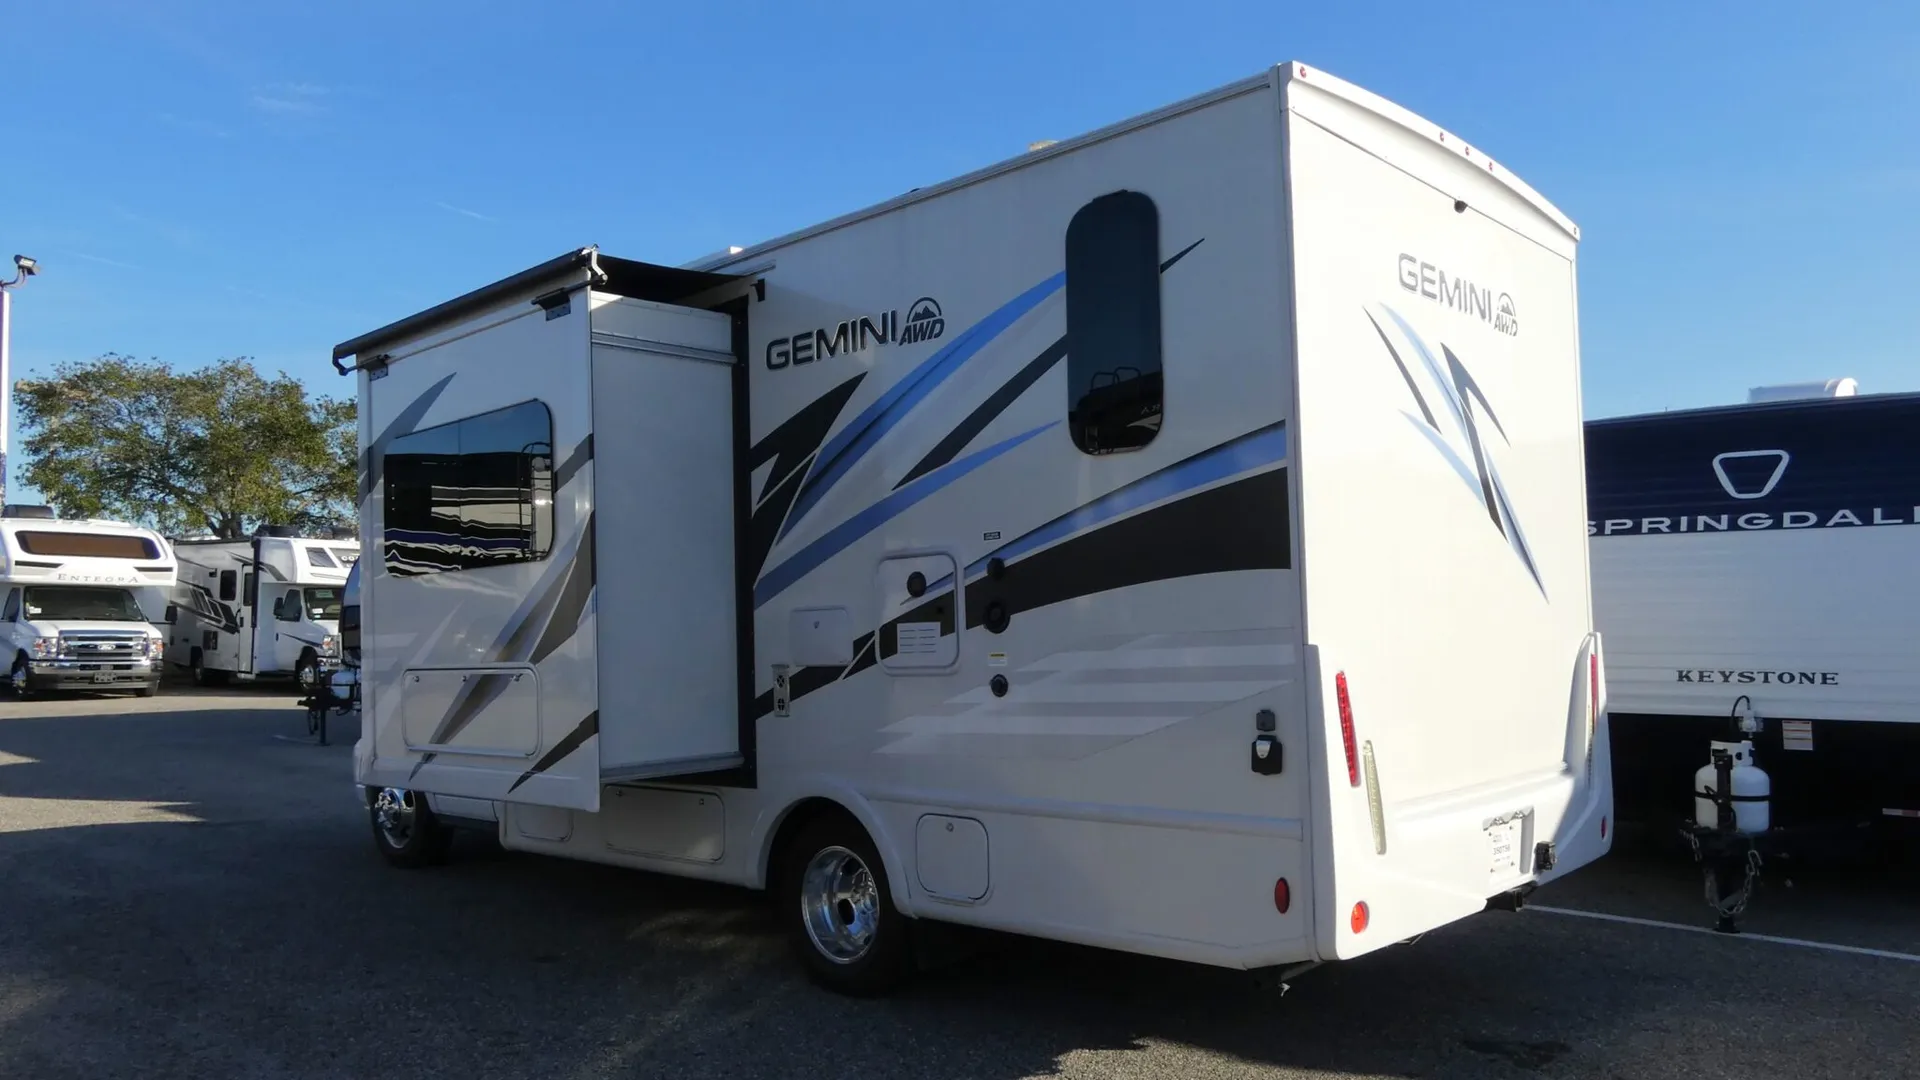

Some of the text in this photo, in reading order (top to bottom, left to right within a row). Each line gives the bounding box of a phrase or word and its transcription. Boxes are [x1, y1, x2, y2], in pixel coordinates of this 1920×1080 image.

[1398, 252, 1492, 324] GEMINI
[898, 317, 945, 347] AWD
[1494, 313, 1518, 337] AWD
[766, 310, 897, 371] GEMINI
[1587, 505, 1920, 536] PRINGDAL
[57, 573, 139, 583] ENTEGRA
[1676, 669, 1840, 686] KEYSTONE
